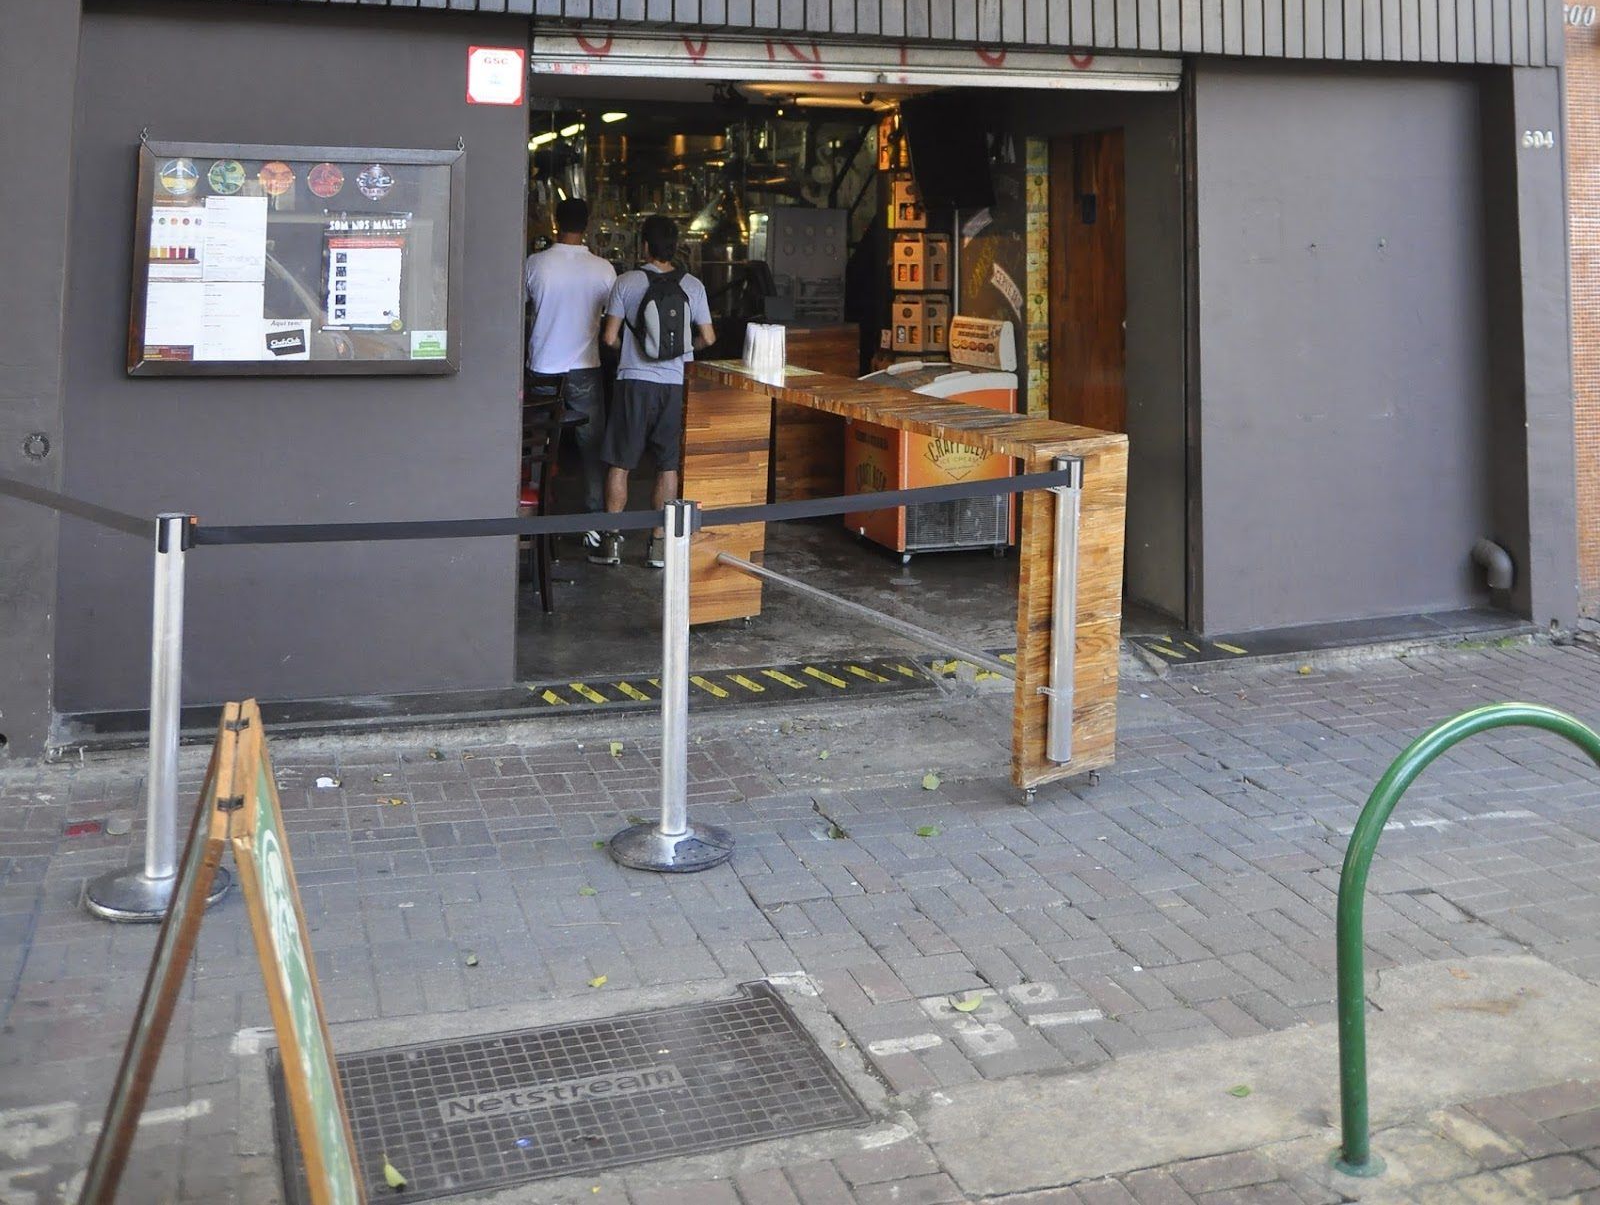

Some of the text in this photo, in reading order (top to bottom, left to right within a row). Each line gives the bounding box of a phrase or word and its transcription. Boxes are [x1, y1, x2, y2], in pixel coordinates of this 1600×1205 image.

[1521, 130, 1554, 149] 604
[373, 219, 407, 230] MALTES
[448, 1069, 676, 1117] Netstream
